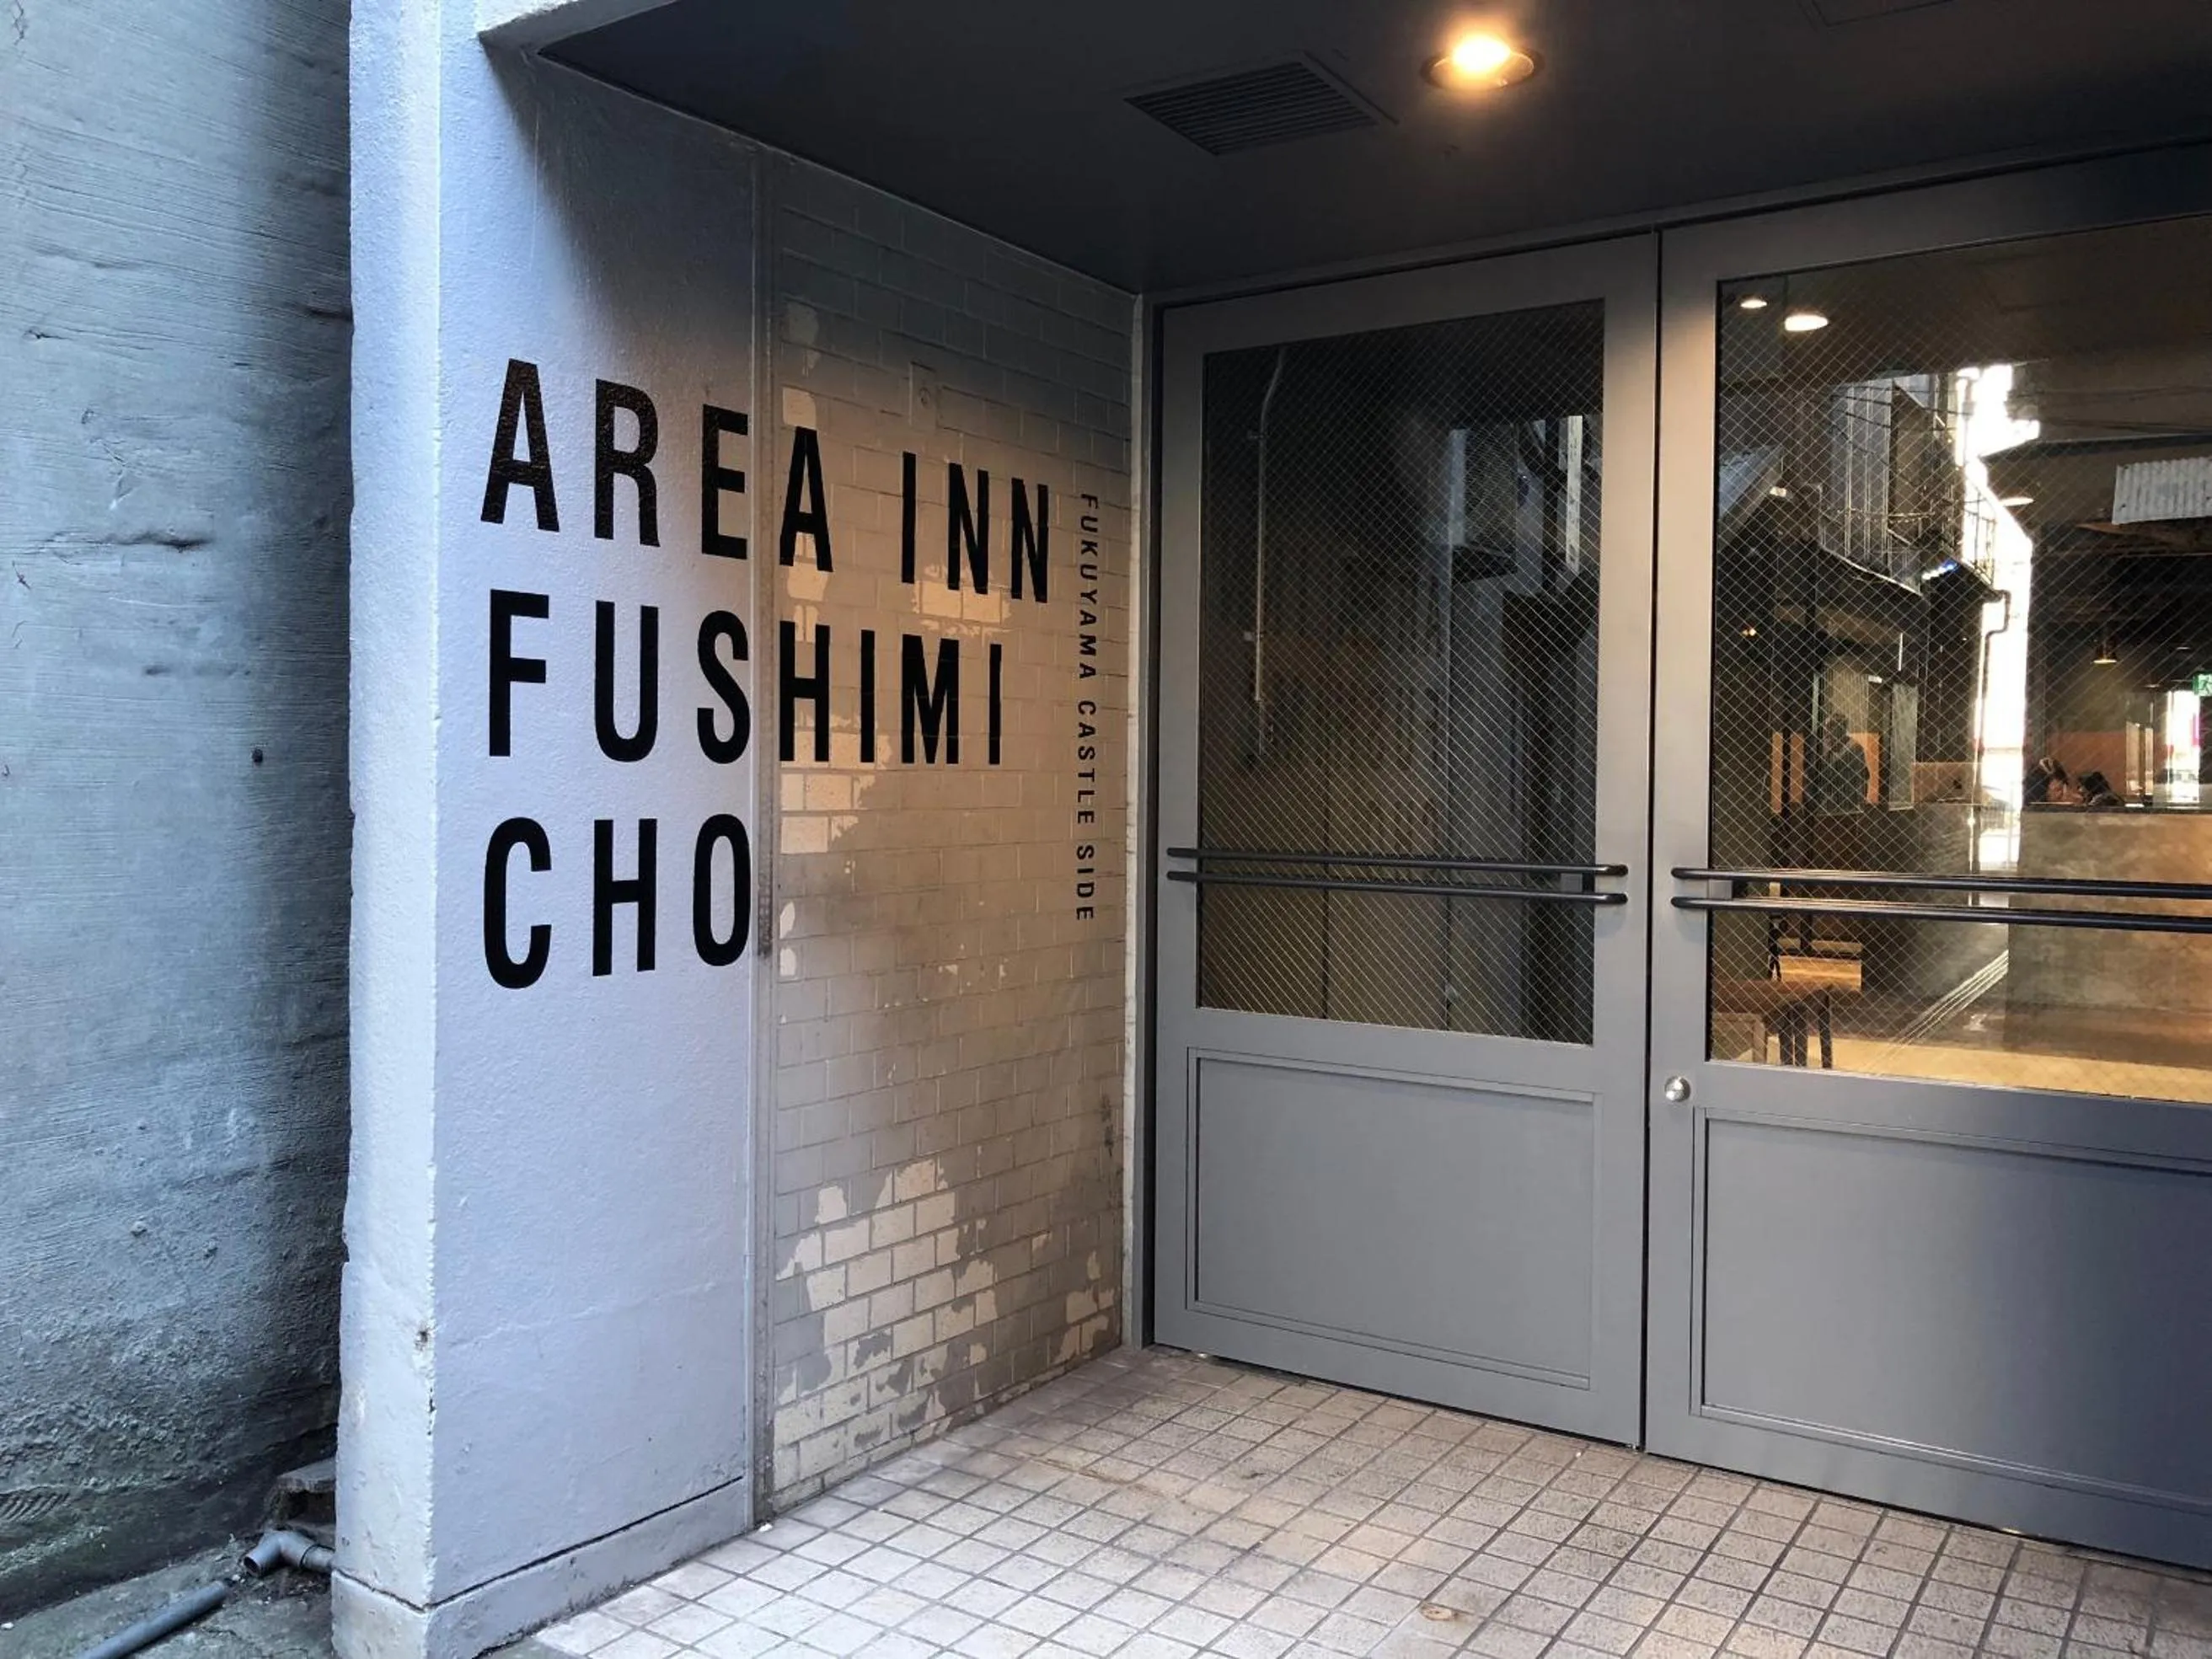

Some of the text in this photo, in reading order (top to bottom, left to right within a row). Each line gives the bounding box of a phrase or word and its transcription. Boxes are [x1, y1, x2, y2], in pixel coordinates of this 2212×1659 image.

[480, 358, 1048, 603] AREA INN
[489, 589, 1002, 764] FUSHIMI
[1076, 493, 1099, 920] FUKUYAMA CASTLE SIDE
[483, 813, 751, 989] CHO
